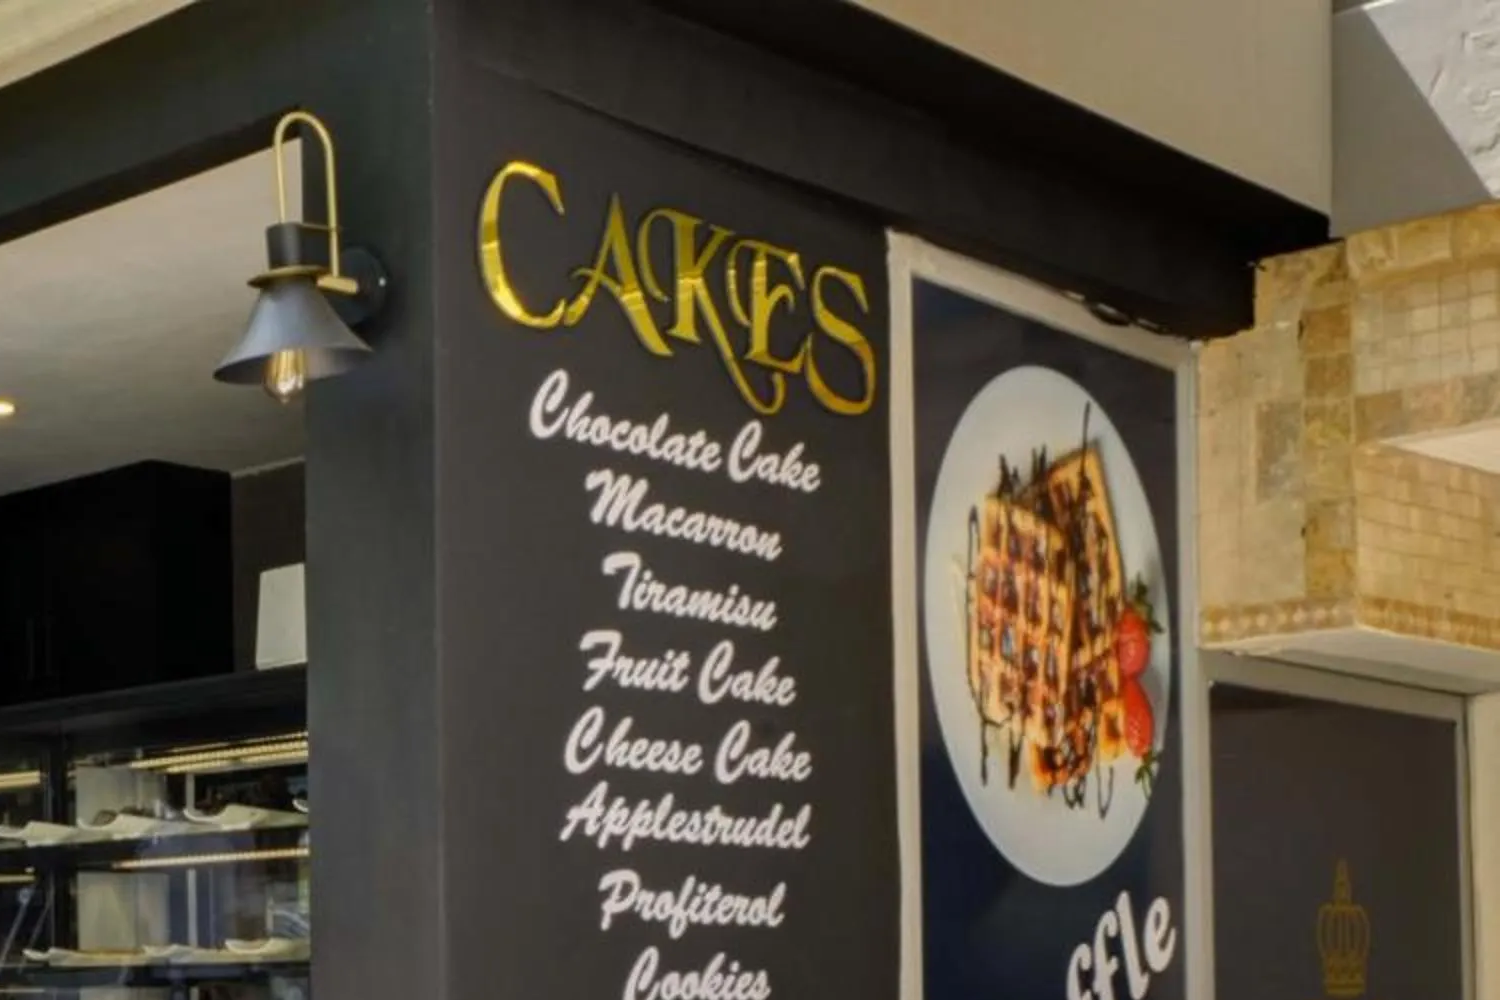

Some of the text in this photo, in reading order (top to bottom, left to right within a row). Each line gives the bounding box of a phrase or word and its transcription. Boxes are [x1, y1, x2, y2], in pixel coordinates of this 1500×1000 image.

[478, 160, 877, 415] CAKES
[528, 367, 822, 493] Chocolate Cake
[585, 468, 783, 560] Macarron
[602, 550, 778, 632] Tiramisu
[579, 629, 797, 707] Fruit Cake
[564, 706, 813, 784] Cheese Cake
[558, 780, 813, 851] Applestrudel
[598, 868, 787, 940] Profiterol
